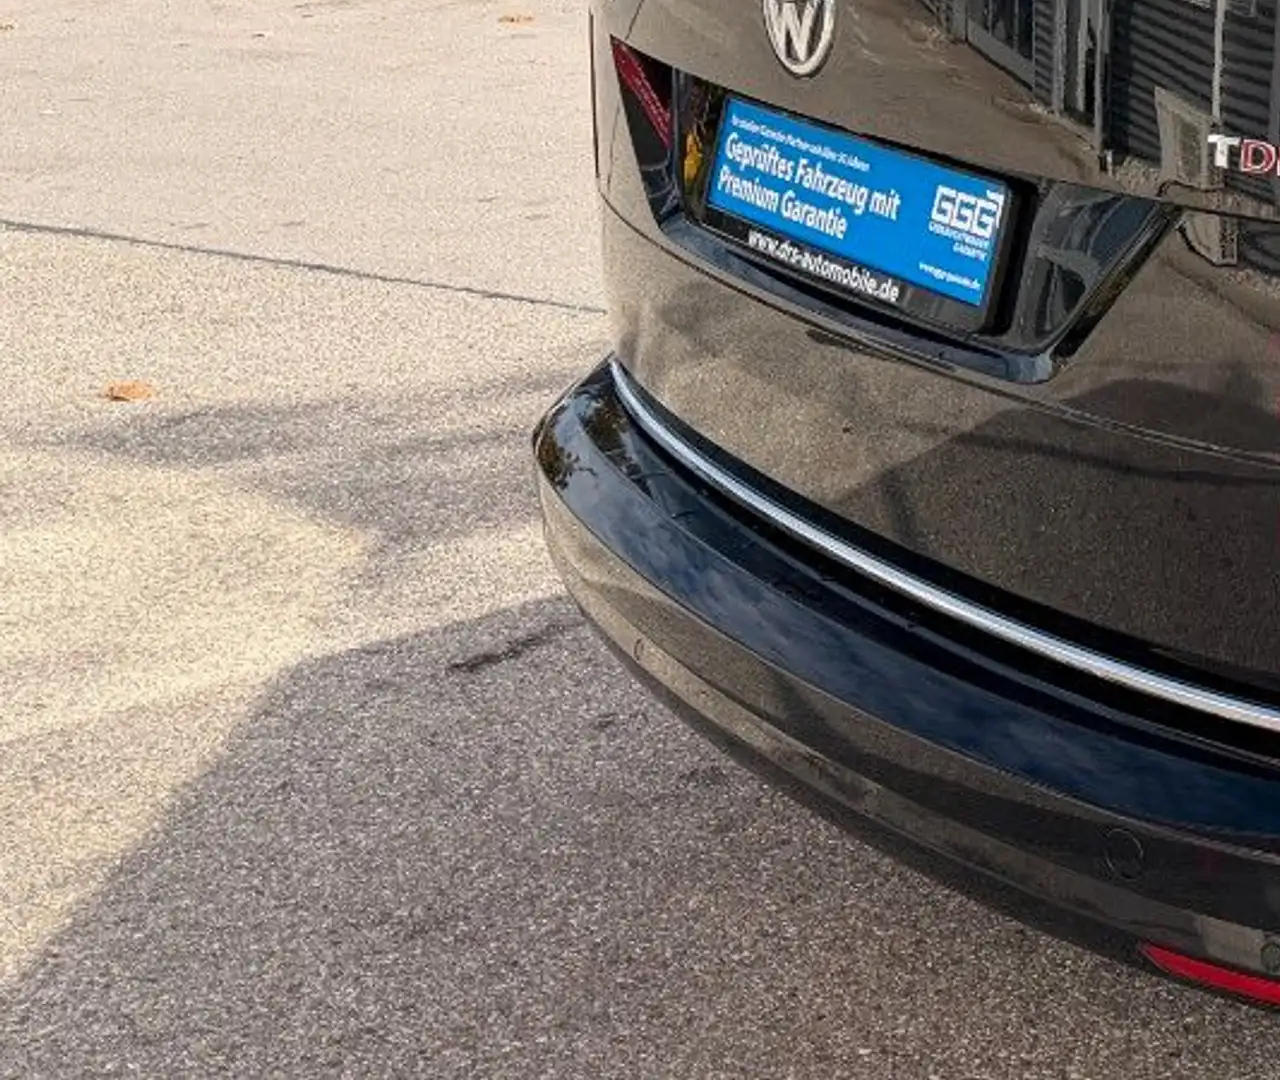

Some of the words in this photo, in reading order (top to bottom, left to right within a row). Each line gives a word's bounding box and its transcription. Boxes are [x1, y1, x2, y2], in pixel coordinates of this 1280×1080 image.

[717, 163, 780, 213] Premium
[780, 189, 848, 240] Garantie
[725, 131, 795, 182] Geprüftes
[795, 158, 870, 216] Fahrzeug
[869, 188, 902, 221] mit
